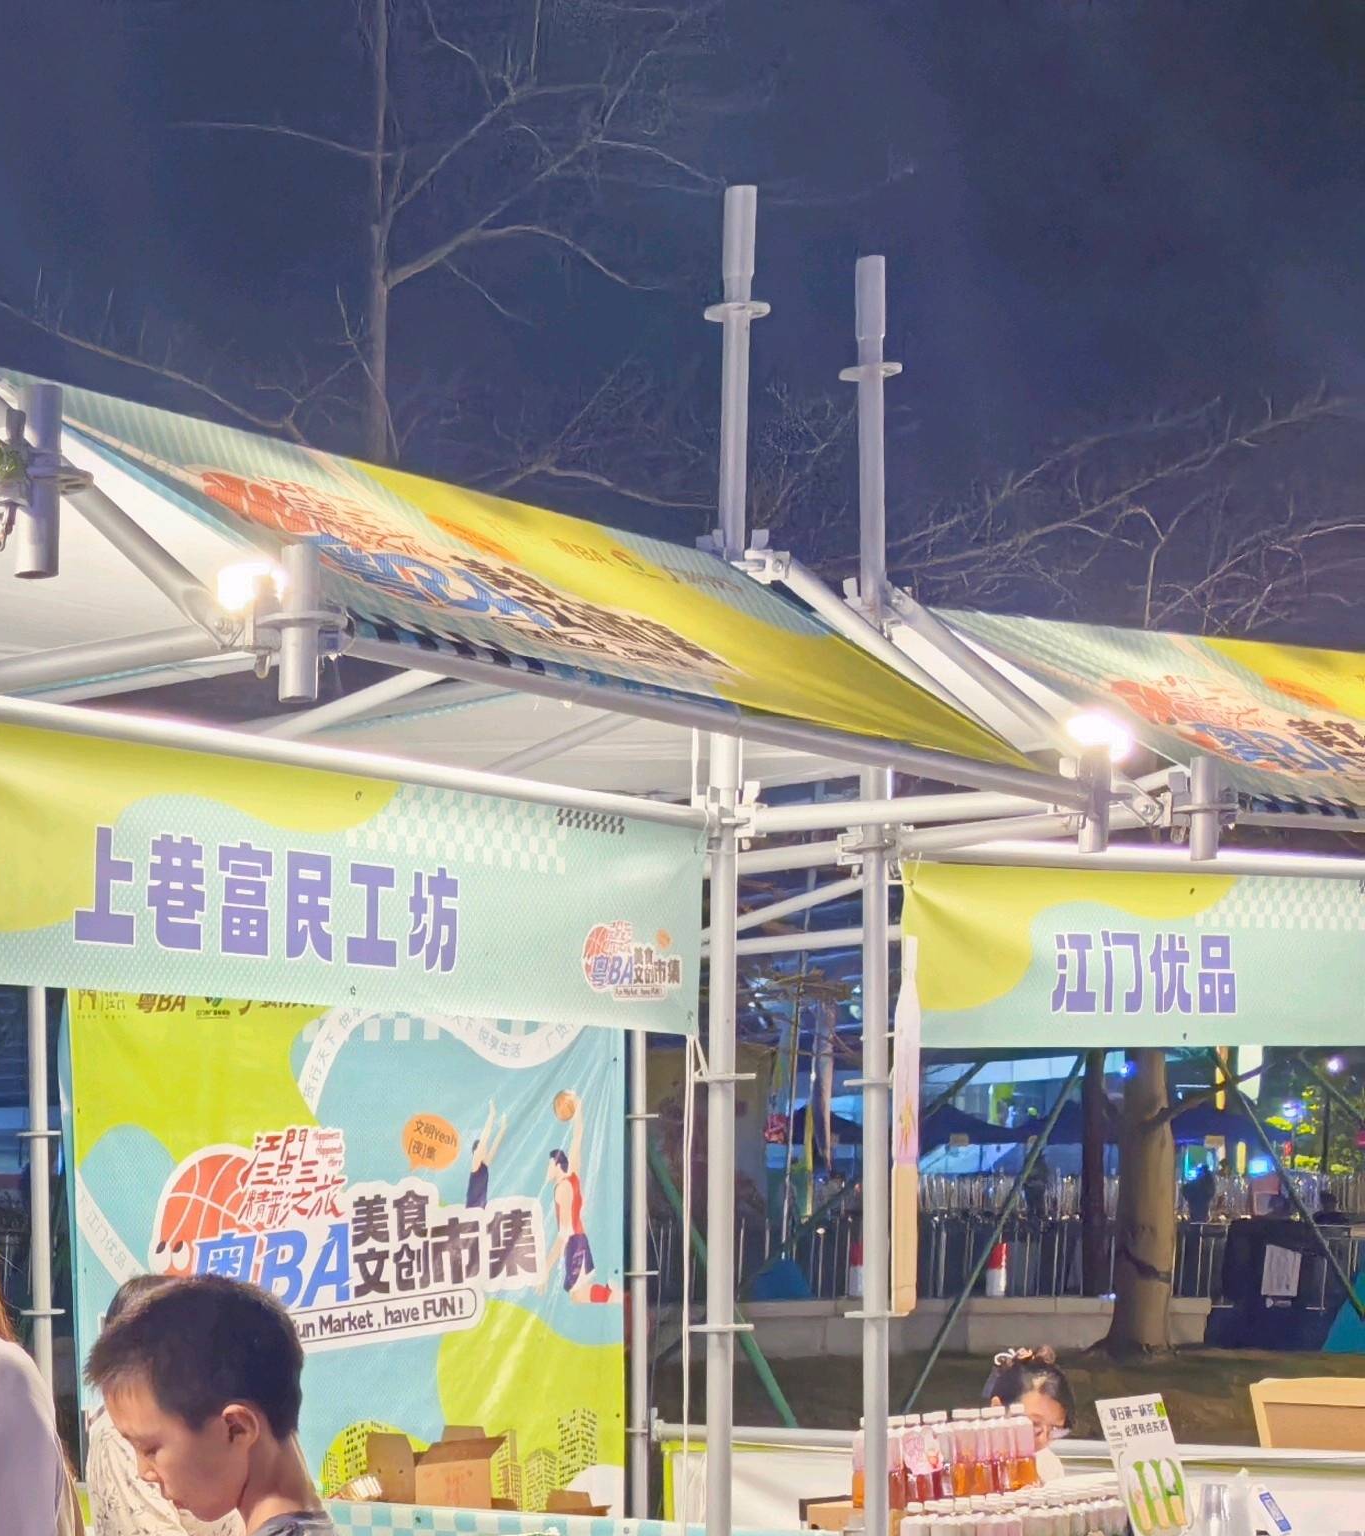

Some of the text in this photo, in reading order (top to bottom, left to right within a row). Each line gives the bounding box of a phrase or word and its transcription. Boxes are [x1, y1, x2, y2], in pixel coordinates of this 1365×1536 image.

[73, 826, 461, 974] 上巷富民工坊
[1051, 929, 1238, 1015] 江门优品
[351, 1189, 430, 1246] 美食
[429, 1208, 538, 1286] 市集
[353, 1238, 431, 1298] 文创
[384, 1304, 420, 1325] have
